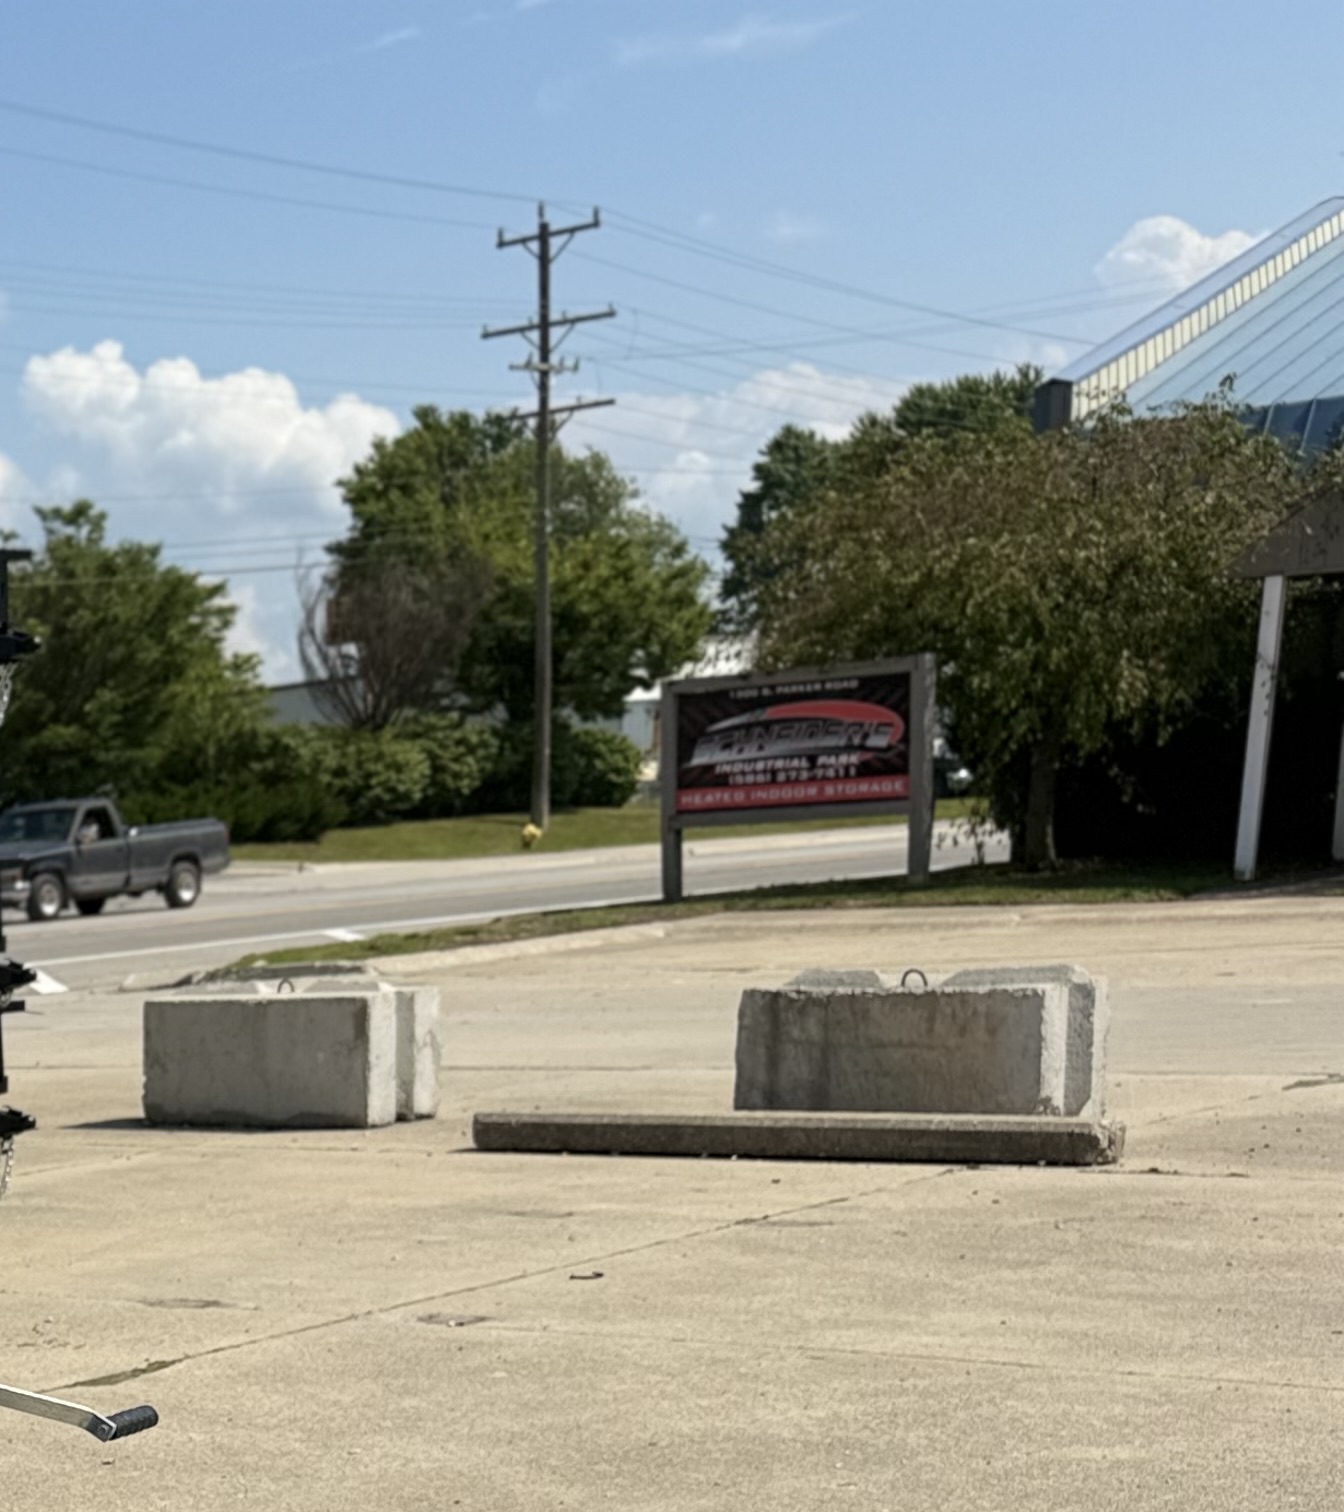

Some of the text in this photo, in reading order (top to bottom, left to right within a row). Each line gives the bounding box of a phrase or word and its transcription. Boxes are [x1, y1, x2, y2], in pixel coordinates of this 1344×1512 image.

[714, 753, 860, 775] INDUSTRIAL PARK
[681, 780, 904, 804] HEATED INDOOR STORAGE
